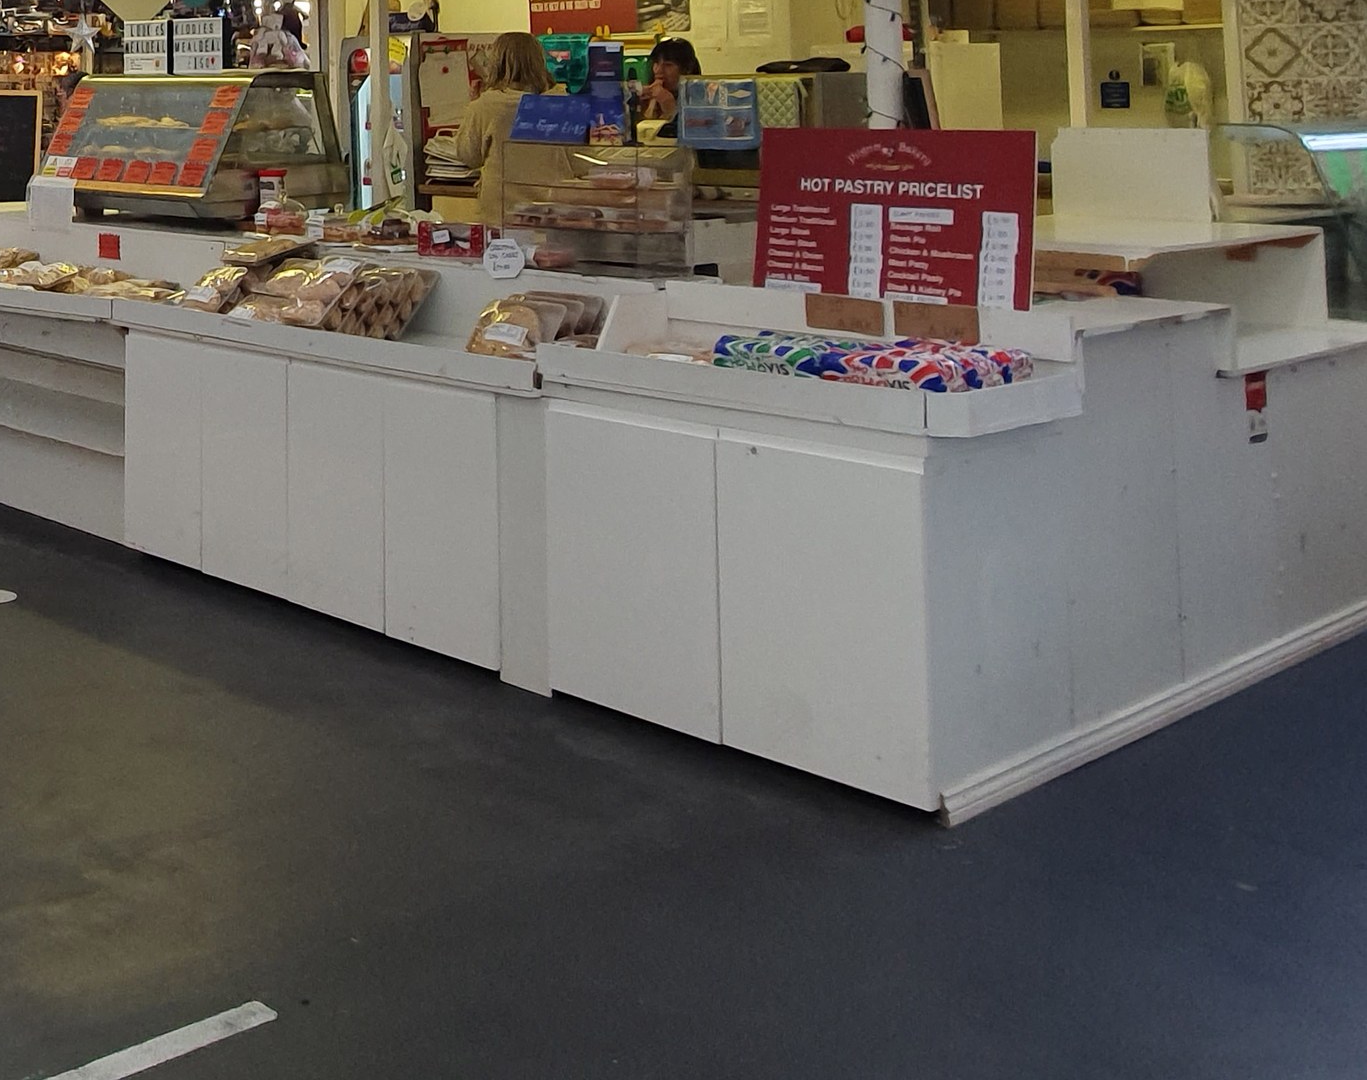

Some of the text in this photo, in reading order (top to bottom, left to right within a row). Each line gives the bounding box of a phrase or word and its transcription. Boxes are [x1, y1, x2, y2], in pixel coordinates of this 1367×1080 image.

[800, 178, 985, 200] HOT PASTRY PRICELIST
